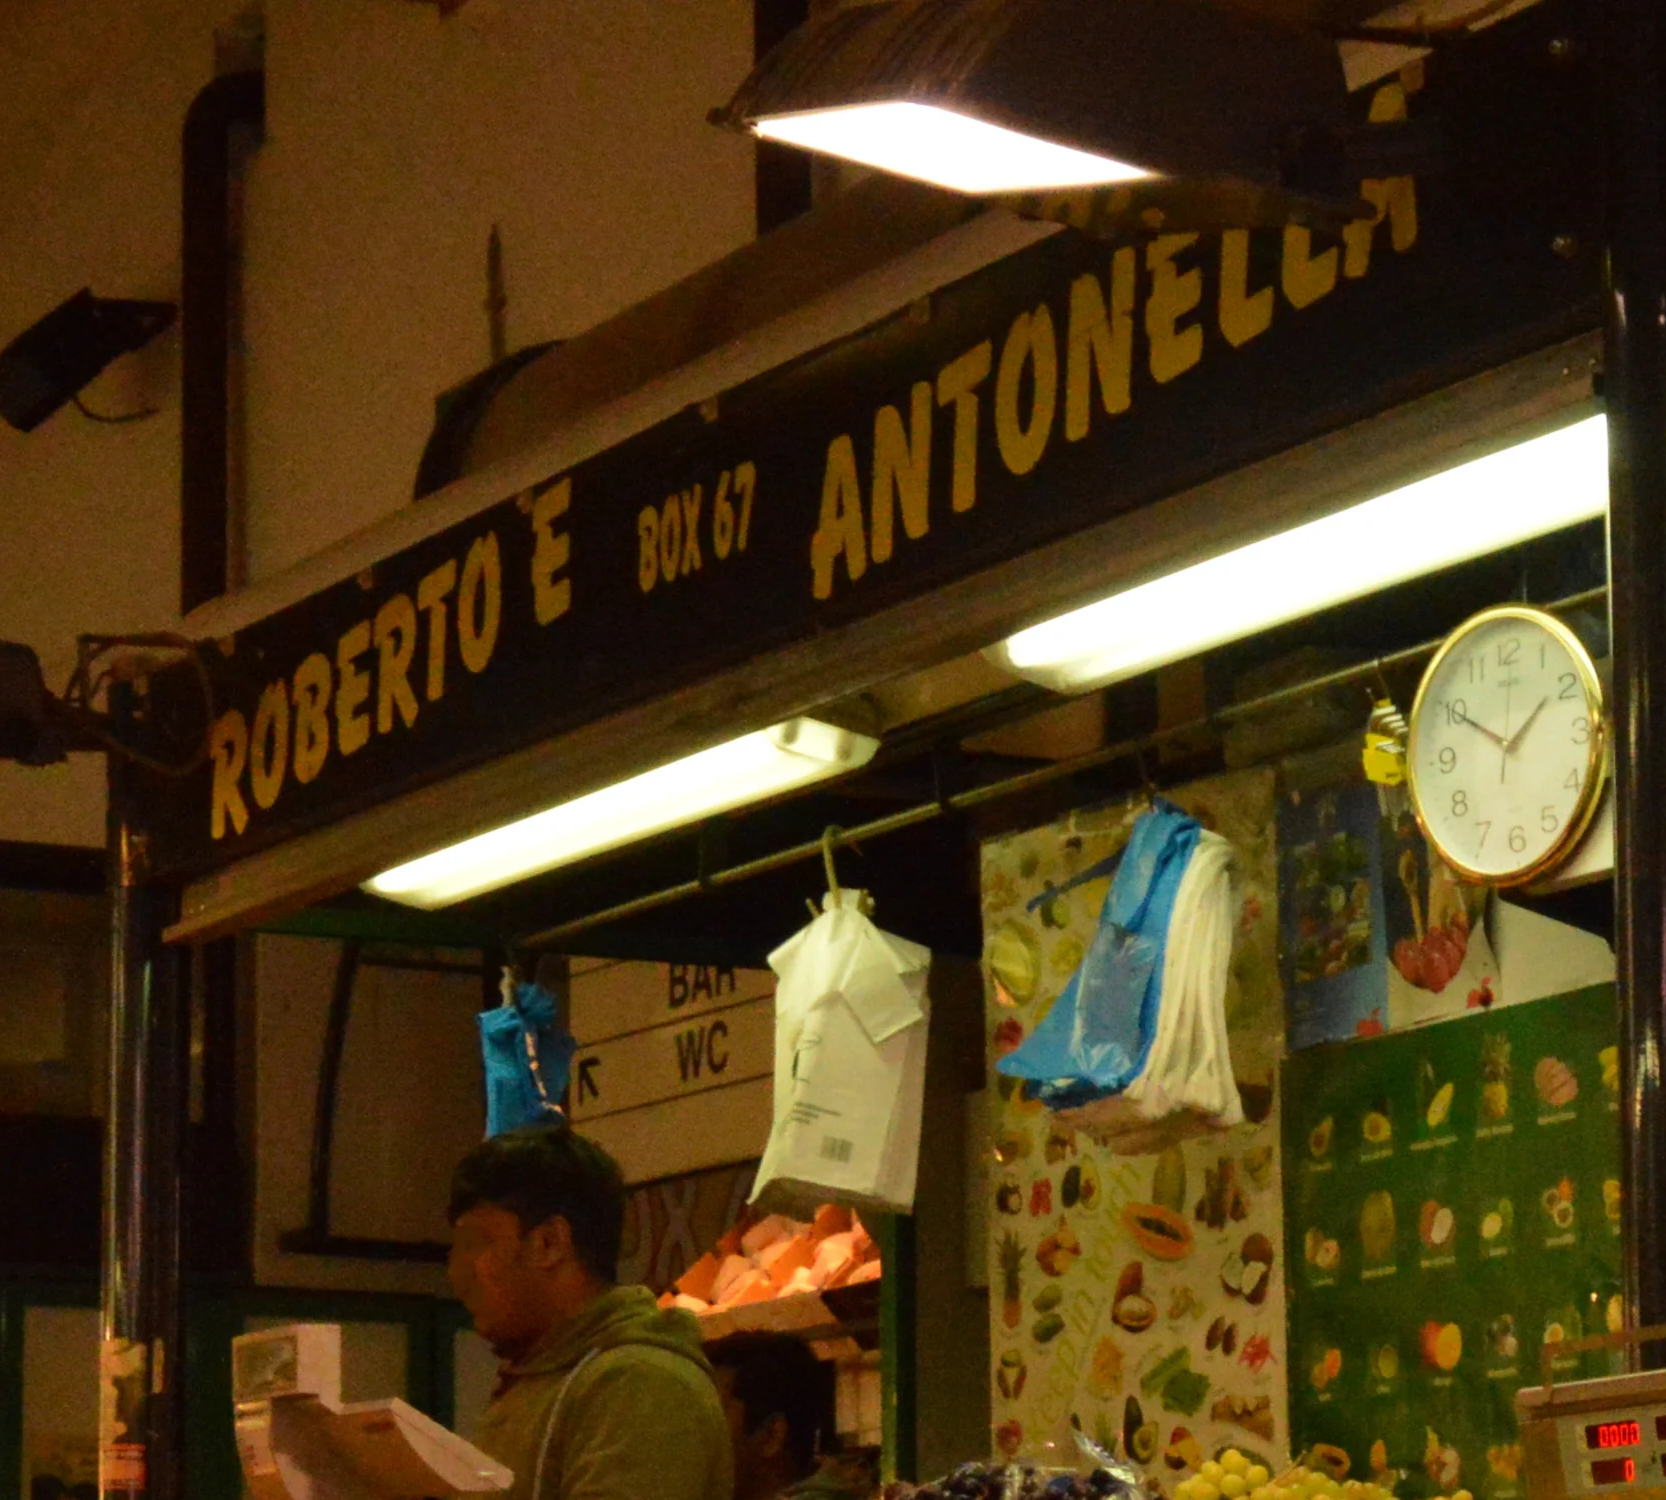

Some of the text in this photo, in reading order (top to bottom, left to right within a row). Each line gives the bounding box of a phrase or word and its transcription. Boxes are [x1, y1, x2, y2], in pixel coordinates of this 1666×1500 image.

[637, 461, 757, 594] BOX 67
[209, 478, 574, 842] ROBERTO E
[1497, 638, 1520, 666] 12
[1469, 657, 1485, 684] 11
[1558, 672, 1577, 701] 2
[1445, 698, 1466, 726] 10
[1571, 717, 1590, 745] 3
[1438, 747, 1457, 774] 9
[1563, 767, 1582, 793] 4
[1451, 790, 1468, 817] 8
[1540, 804, 1559, 833] 5
[1475, 820, 1492, 847] 7
[1508, 826, 1527, 853] 6
[676, 1021, 730, 1081] WC
[1624, 1457, 1635, 1482] 0
